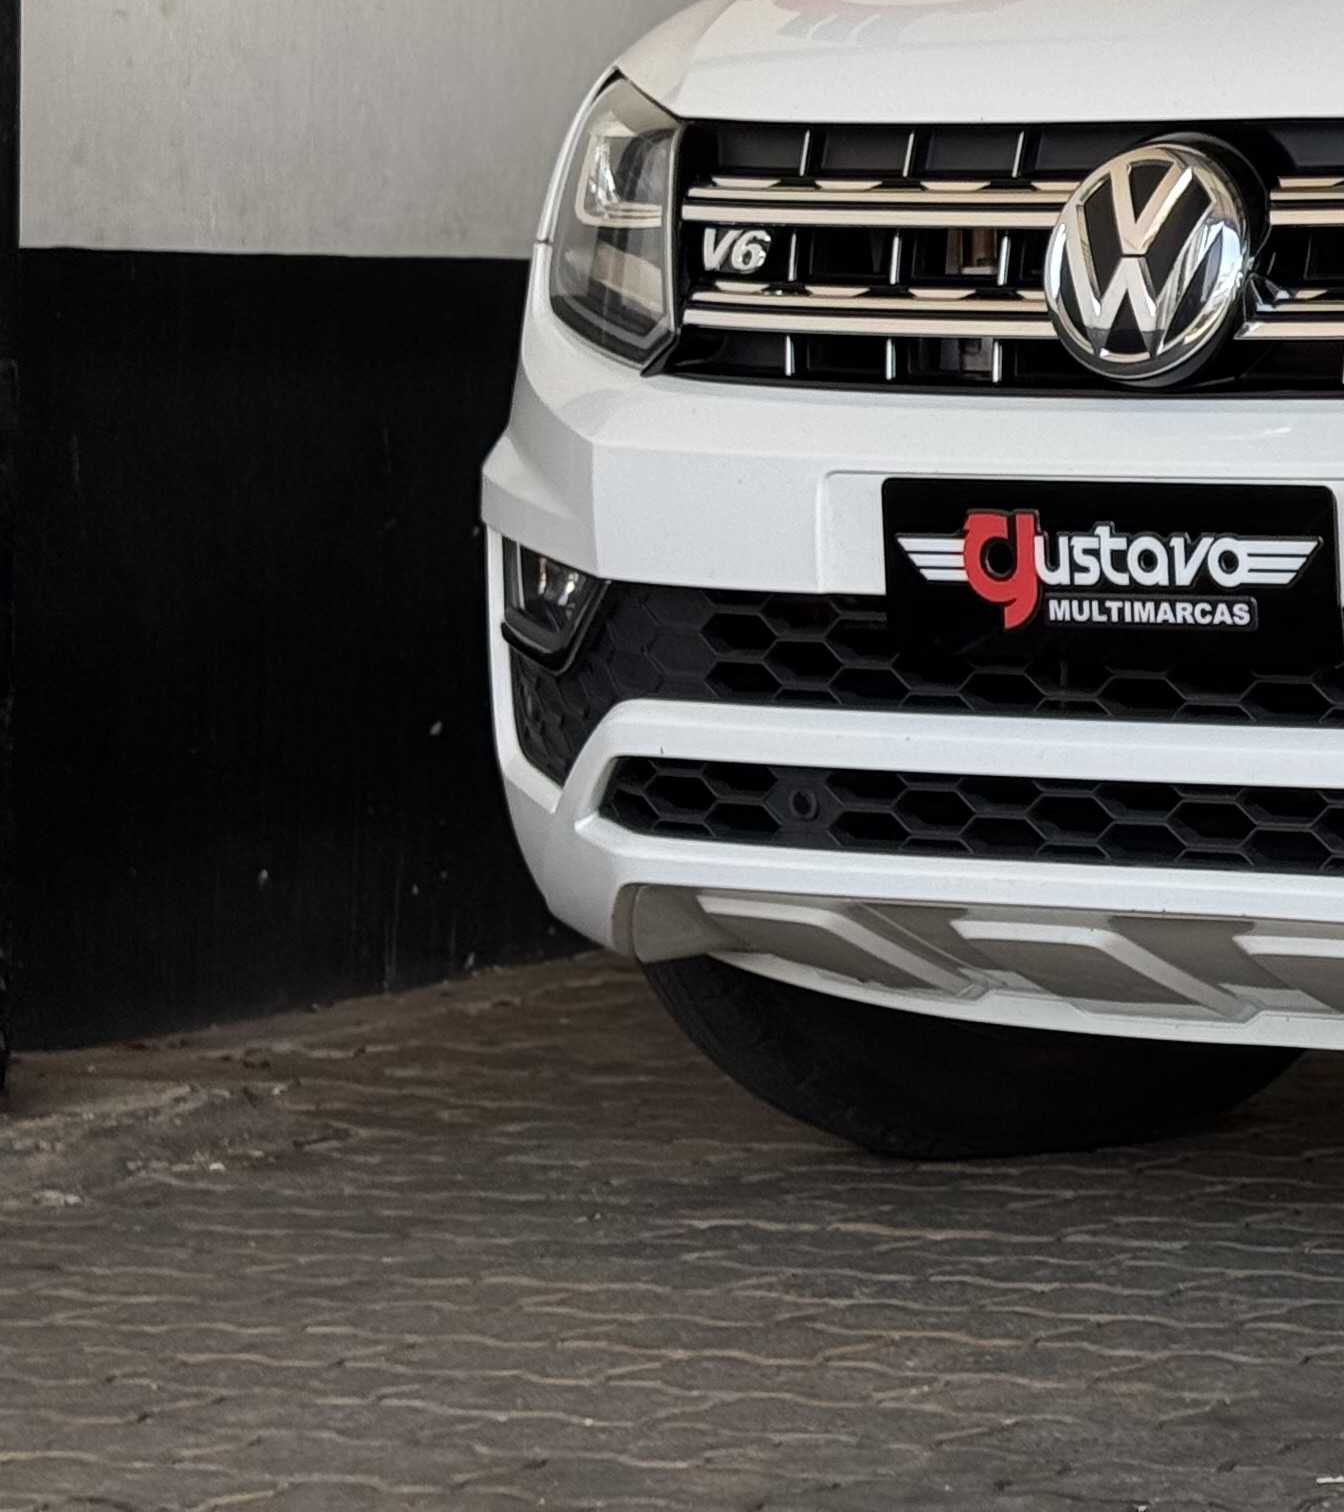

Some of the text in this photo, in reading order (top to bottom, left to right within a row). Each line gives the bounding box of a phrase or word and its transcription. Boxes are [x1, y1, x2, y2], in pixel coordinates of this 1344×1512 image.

[703, 226, 772, 273] V6
[962, 512, 1240, 630] gustavo
[1049, 598, 1251, 626] MULTIMARCAS
